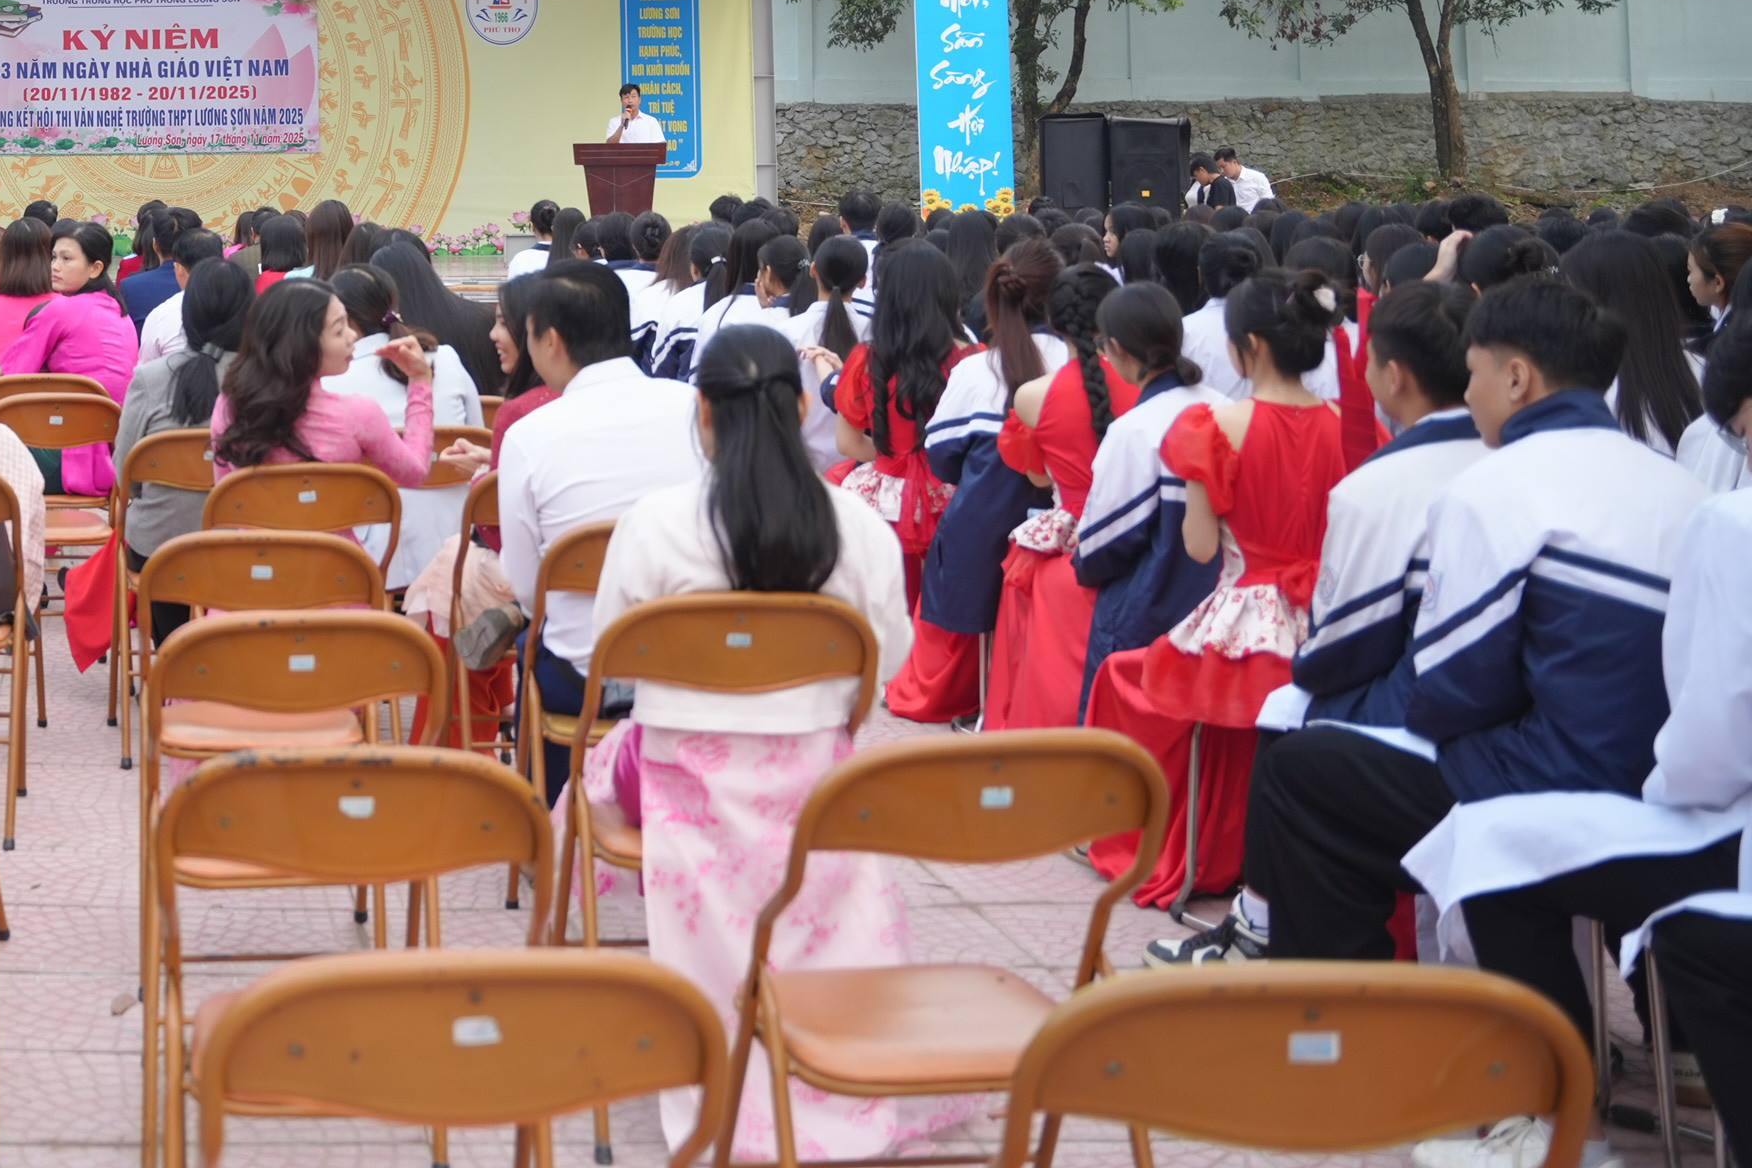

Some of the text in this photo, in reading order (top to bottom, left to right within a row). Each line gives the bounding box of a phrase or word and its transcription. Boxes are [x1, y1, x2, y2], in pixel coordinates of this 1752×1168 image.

[62, 23, 218, 54] KỶ NIỆM
[940, 23, 985, 53] Sẵn
[16, 59, 57, 79] NĂM
[63, 58, 110, 79] NGÀY
[116, 58, 152, 78] NHÀ
[158, 57, 199, 78] GIÁO
[205, 56, 243, 81] VIỆT
[249, 59, 289, 77] NAM
[929, 60, 997, 99] Sàng
[23, 87, 132, 102] (20/11/1982
[148, 85, 257, 101] 20/11/2025)
[16, 105, 34, 127] KẾT
[37, 107, 53, 130] HỘI
[56, 110, 71, 127] THI
[74, 107, 94, 127] VĂN
[97, 107, 123, 131] NGHỆ
[126, 105, 165, 127] TRƯỜNG
[168, 109, 192, 126] THPT
[195, 107, 228, 126] LƯƠNG
[230, 107, 250, 125] SƠN
[254, 105, 276, 125] NĂM
[279, 108, 303, 125] 2025
[947, 102, 984, 146] Hội
[137, 134, 163, 147] Lương
[187, 133, 207, 147] ngày
[210, 134, 220, 144] 17
[223, 132, 247, 146] tháng
[250, 133, 259, 144] 11
[262, 133, 281, 144] năm
[283, 132, 304, 143] 2025
[933, 145, 1001, 196] Nhập!
